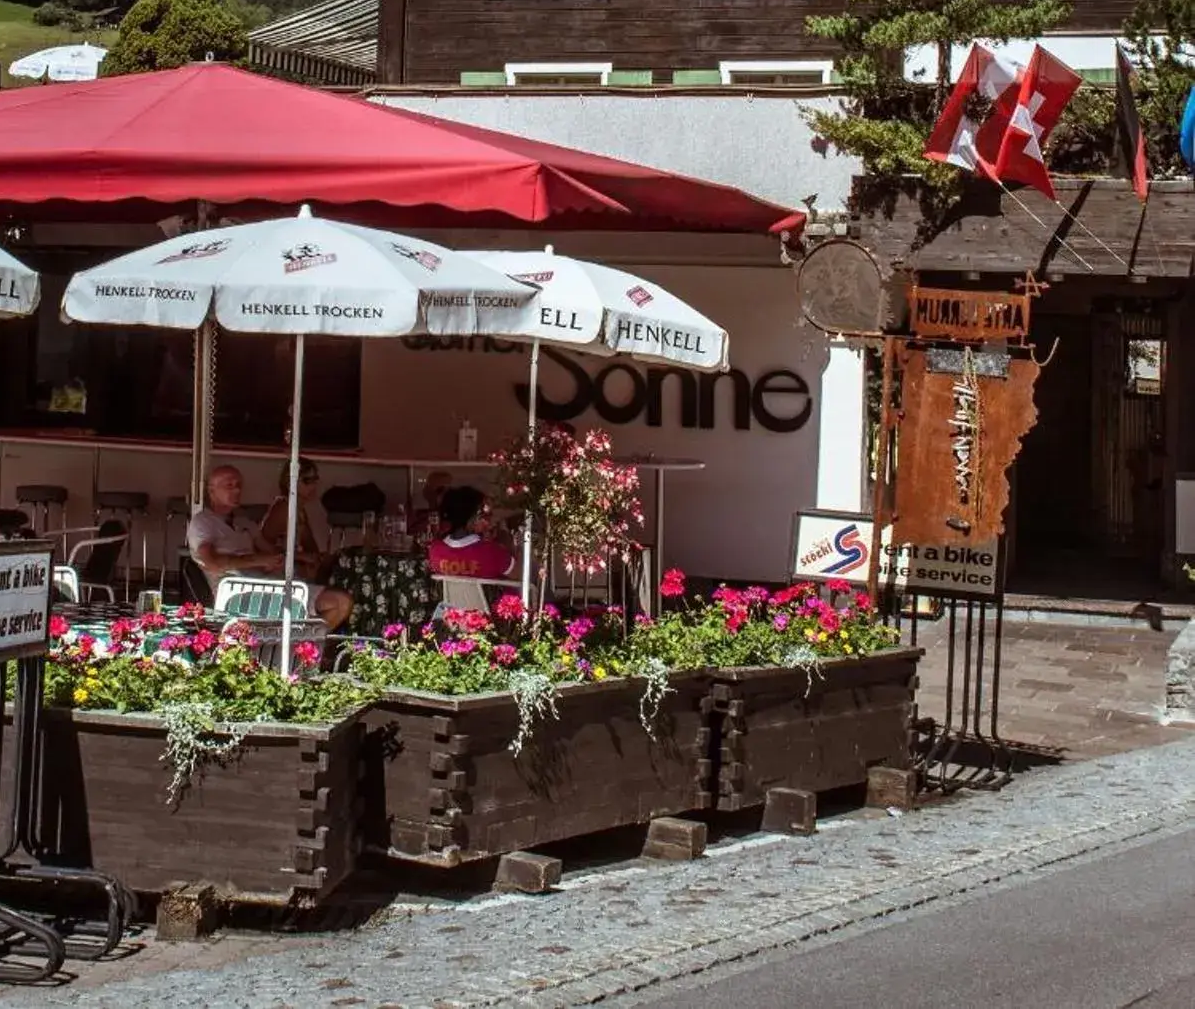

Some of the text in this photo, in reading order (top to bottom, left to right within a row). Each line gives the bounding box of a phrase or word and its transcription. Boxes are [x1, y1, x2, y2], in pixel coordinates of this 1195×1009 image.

[95, 285, 196, 301] HENKELL TROCKEN
[433, 296, 471, 307] HENKELL
[241, 303, 384, 319] HENKELL TROCKEN
[617, 319, 706, 354] HENKELL
[514, 347, 813, 433] Sonne
[878, 542, 994, 567] ent a bike
[13, 569, 21, 588] a
[22, 564, 46, 587] bike
[915, 568, 993, 586] service
[8, 609, 44, 636] service
